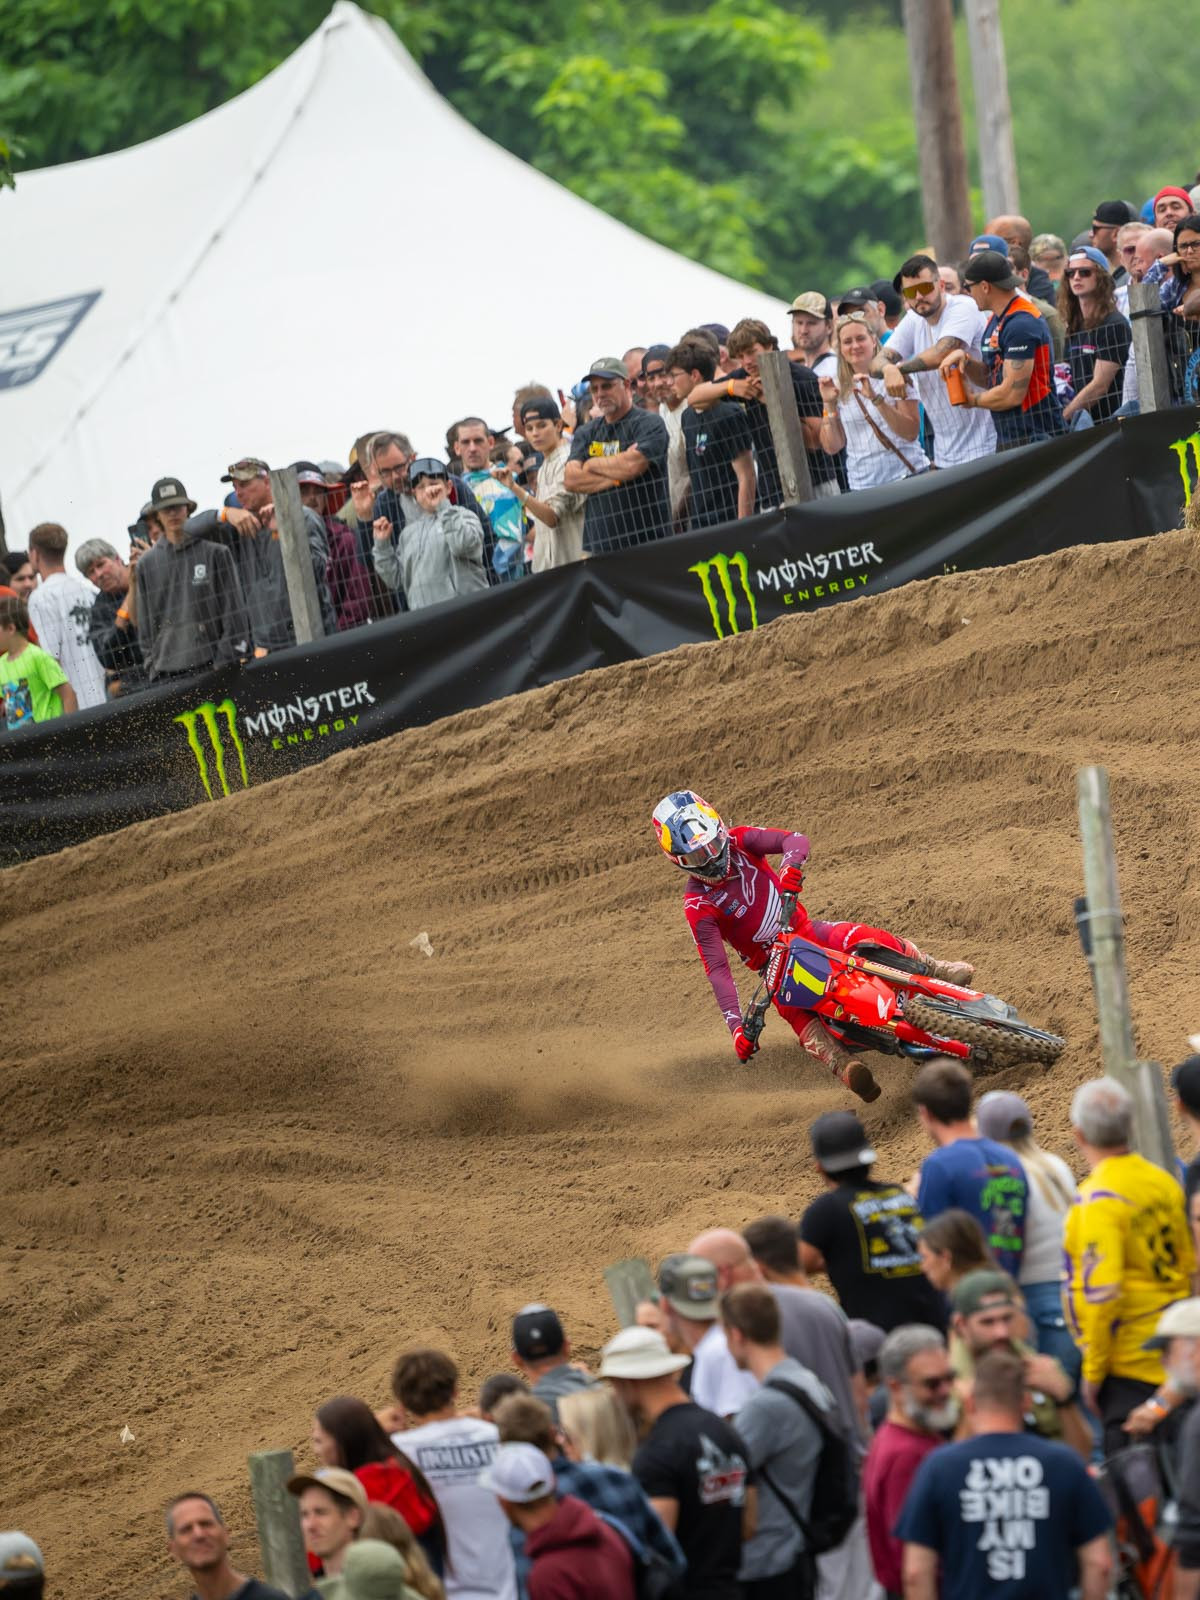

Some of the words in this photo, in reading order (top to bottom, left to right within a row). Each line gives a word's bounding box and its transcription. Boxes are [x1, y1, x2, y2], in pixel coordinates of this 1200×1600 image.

[756, 541, 884, 591] MONSTER
[783, 574, 869, 605] ENERGY
[244, 681, 376, 737] MONSTER
[271, 714, 360, 750] ENERGY
[793, 959, 826, 995] 1
[965, 1455, 1044, 1491] OK?
[959, 1486, 1050, 1522] BIKE
[977, 1520, 1036, 1551] MY
[987, 1550, 1026, 1580] IS
